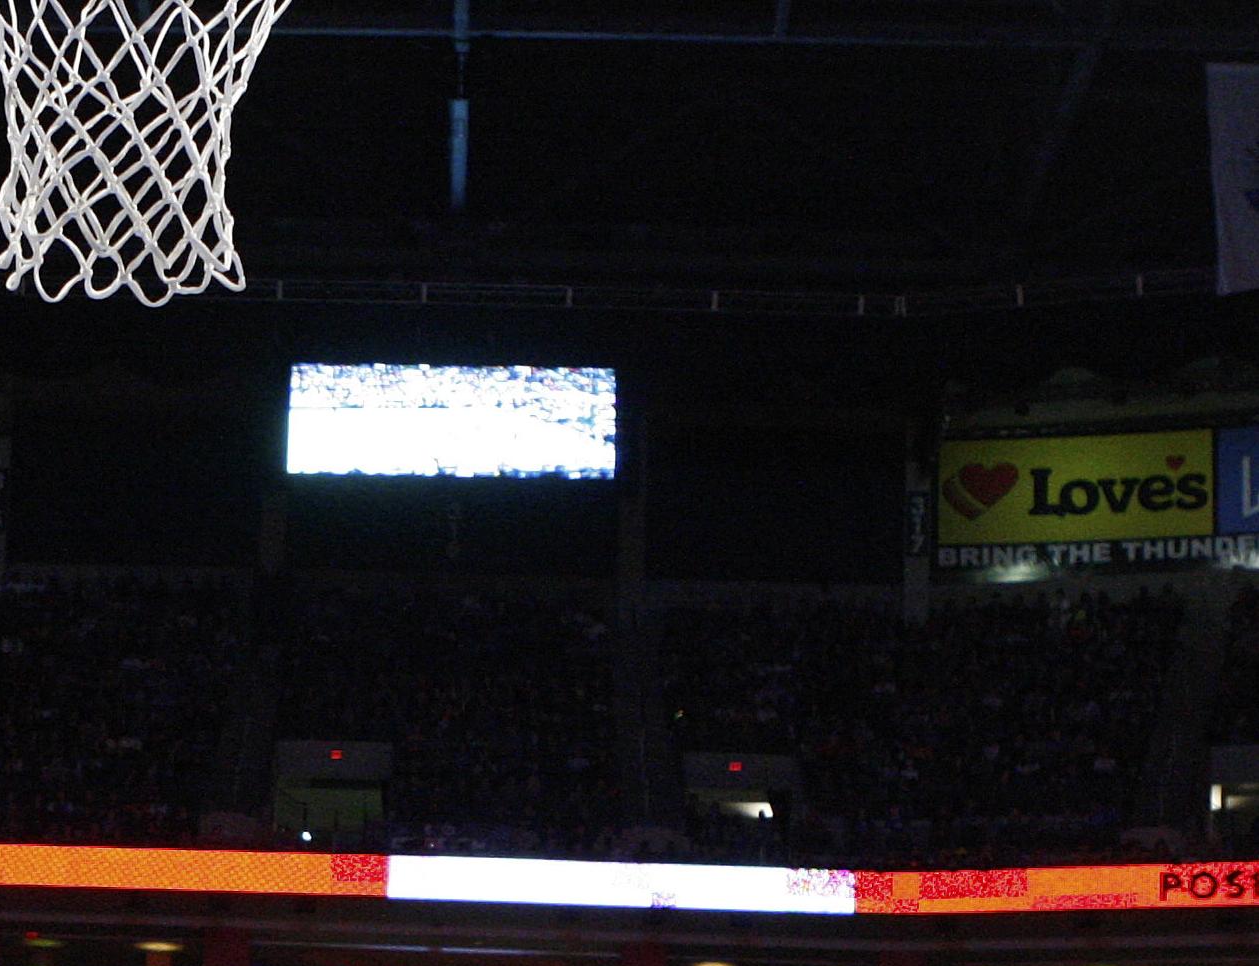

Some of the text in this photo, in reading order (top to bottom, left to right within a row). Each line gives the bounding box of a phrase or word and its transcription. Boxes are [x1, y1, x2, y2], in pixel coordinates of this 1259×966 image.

[1029, 468, 1208, 516] Loves
[939, 545, 1040, 568] BRING
[1046, 540, 1111, 564] THE
